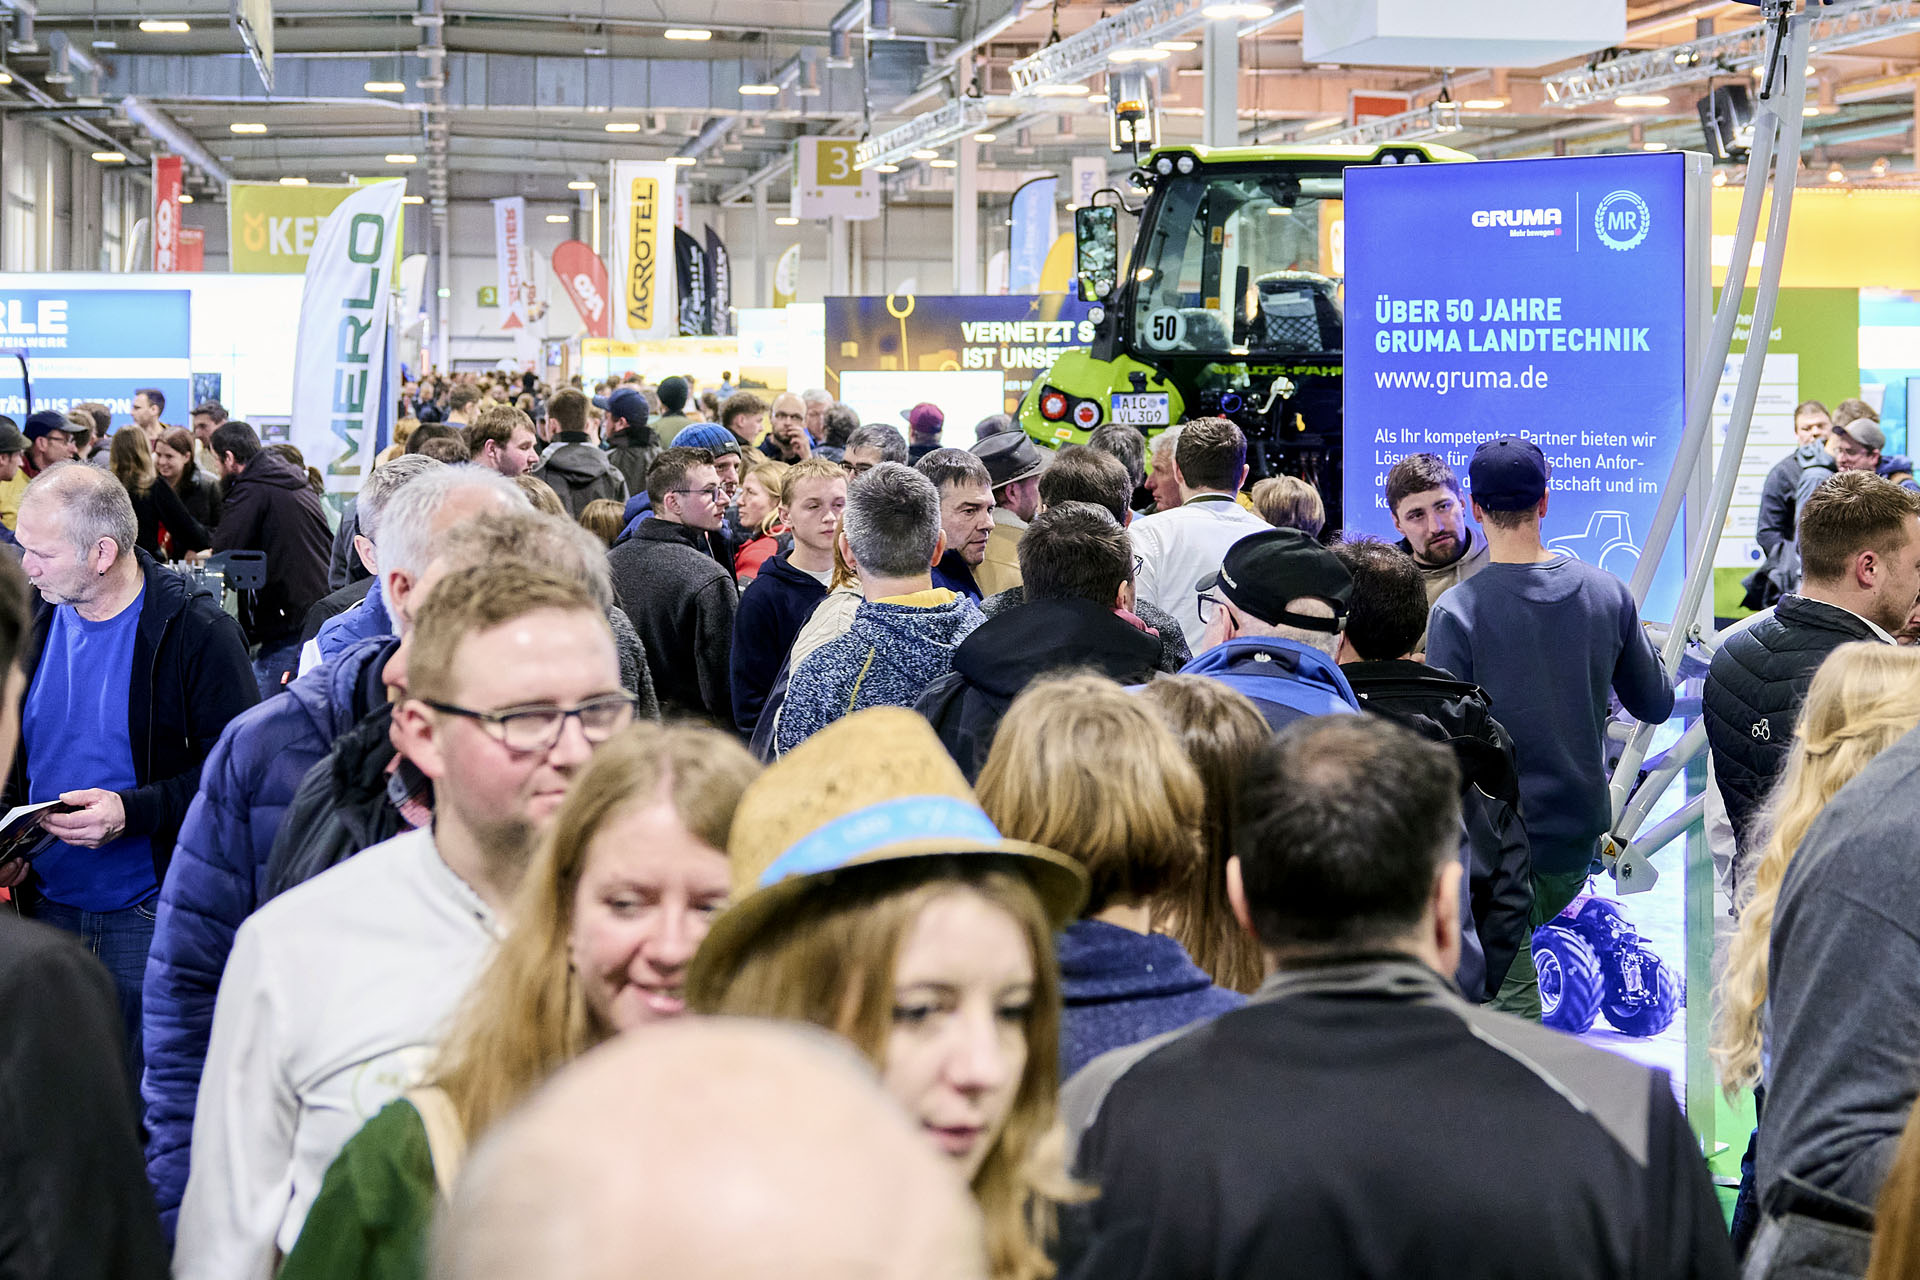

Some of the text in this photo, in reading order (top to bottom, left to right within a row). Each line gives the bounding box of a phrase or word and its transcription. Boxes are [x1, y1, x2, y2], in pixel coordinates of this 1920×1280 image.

[829, 146, 849, 180] 3
[1471, 208, 1562, 228] GRUMA
[1608, 211, 1637, 231] MR
[268, 215, 330, 257] KE
[1509, 228, 1555, 238] Mehr bewegen
[630, 184, 653, 322] AGROTEL
[0, 300, 68, 334] LE
[1375, 294, 1562, 324] ÜBER 50 JAHRE
[961, 320, 1075, 343] VERNETZT
[1153, 315, 1177, 341] 50
[327, 213, 385, 476] MERLO
[1375, 327, 1650, 353] GRUMA LANDTECHNIK
[962, 346, 1070, 369] IST UNSE
[1374, 364, 1549, 394] www.gruma.de
[31, 398, 69, 414] AUS
[1122, 397, 1147, 409] AIC
[1119, 410, 1162, 423] VL 309
[1374, 428, 1397, 443] Als
[1401, 428, 1421, 443] Ihr
[1520, 429, 1577, 445] Partner
[1581, 430, 1627, 446] bieten
[1631, 432, 1657, 447] wir
[1446, 451, 1469, 466] für
[1595, 453, 1645, 469] Anfor-
[1606, 477, 1634, 493] und
[1639, 478, 1658, 493] im
